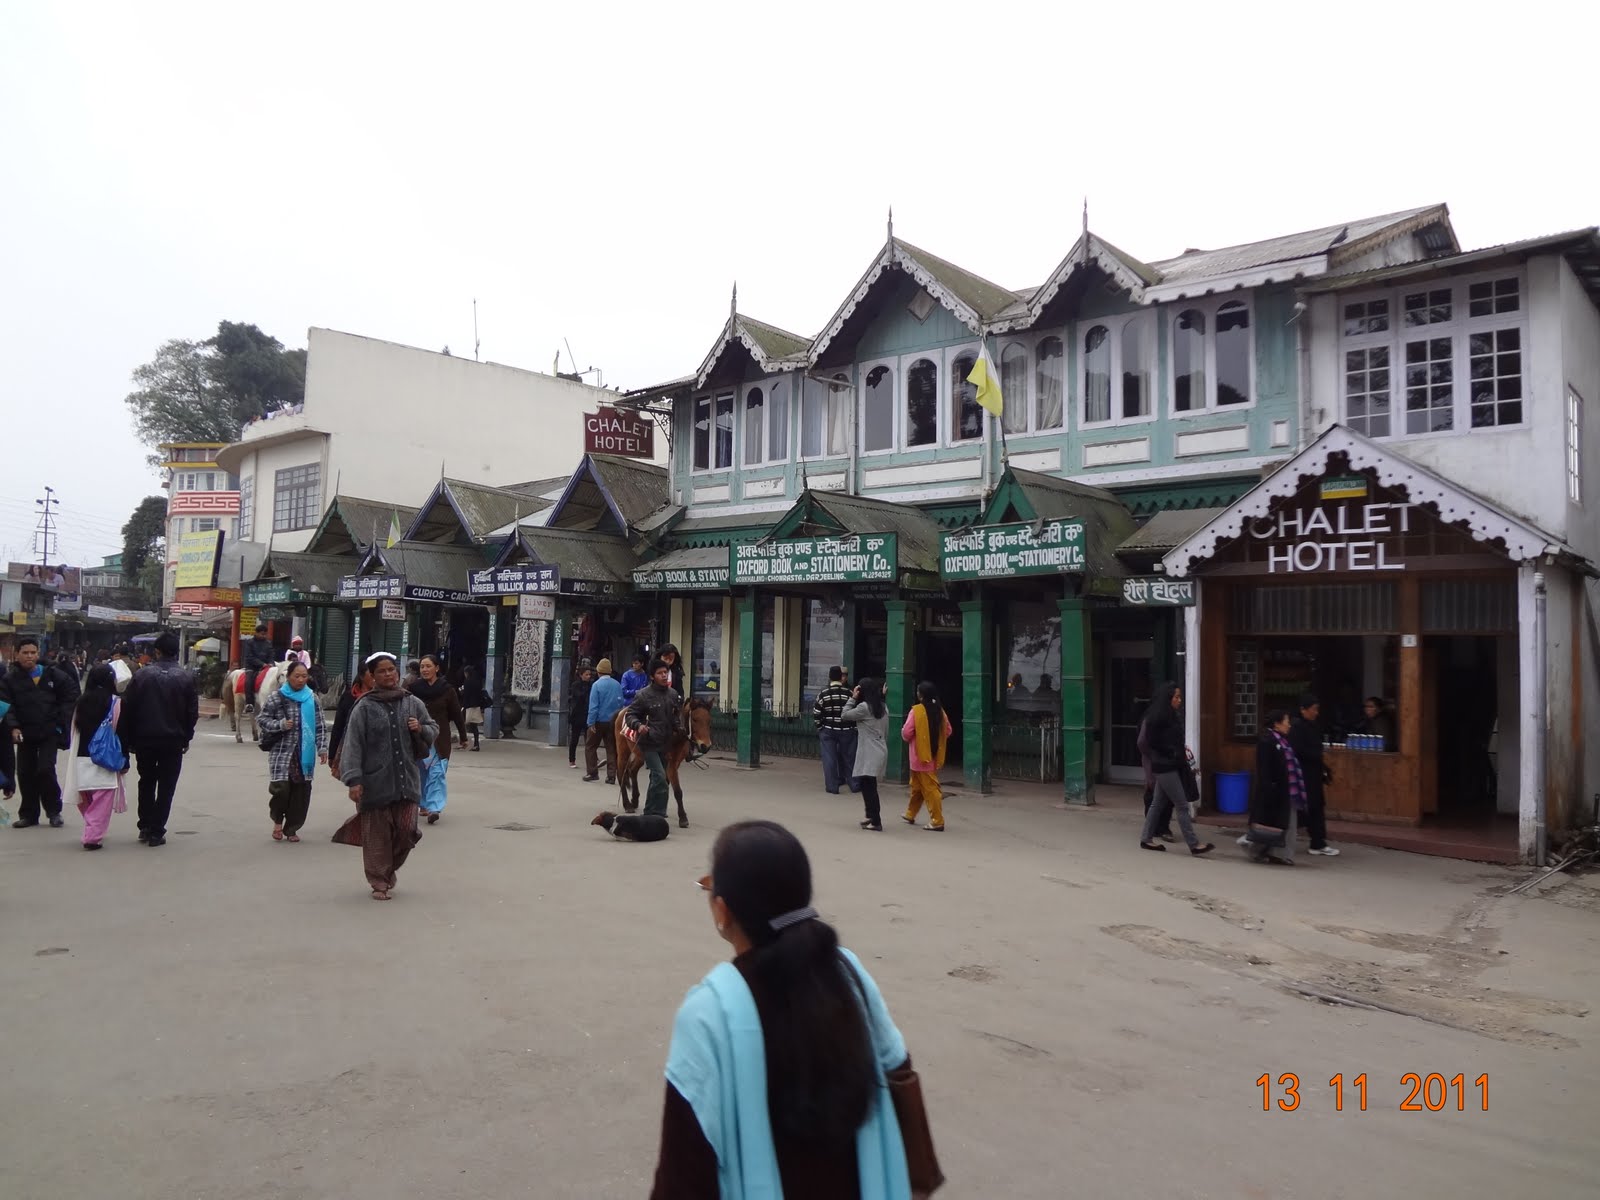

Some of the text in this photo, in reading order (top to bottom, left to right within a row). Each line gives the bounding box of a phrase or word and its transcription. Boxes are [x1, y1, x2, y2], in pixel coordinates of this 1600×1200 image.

[587, 418, 652, 439] CHALET
[595, 435, 647, 453] HOTEL
[1249, 502, 1416, 539] CHALET
[736, 558, 769, 576] OXFORD
[771, 557, 792, 575] BOOK
[794, 562, 809, 571] AND
[810, 554, 870, 573] STATIONERY
[945, 556, 981, 573] OXFORD
[984, 552, 1009, 570] BOOK
[1018, 546, 1072, 567] STATIONERY
[1268, 541, 1406, 573] HOTEL
[665, 570, 689, 583] BOOK
[689, 570, 697, 582] &
[698, 568, 729, 582] STATIO
[977, 567, 1016, 577] GORKHALAND
[412, 587, 445, 599] CURIOS
[471, 583, 495, 593] HABEEB
[497, 582, 524, 592] MULLICK
[526, 583, 539, 591] AND
[573, 581, 597, 593] WOOD
[1150, 578, 1193, 603] होटल
[523, 598, 553, 608] Silver
